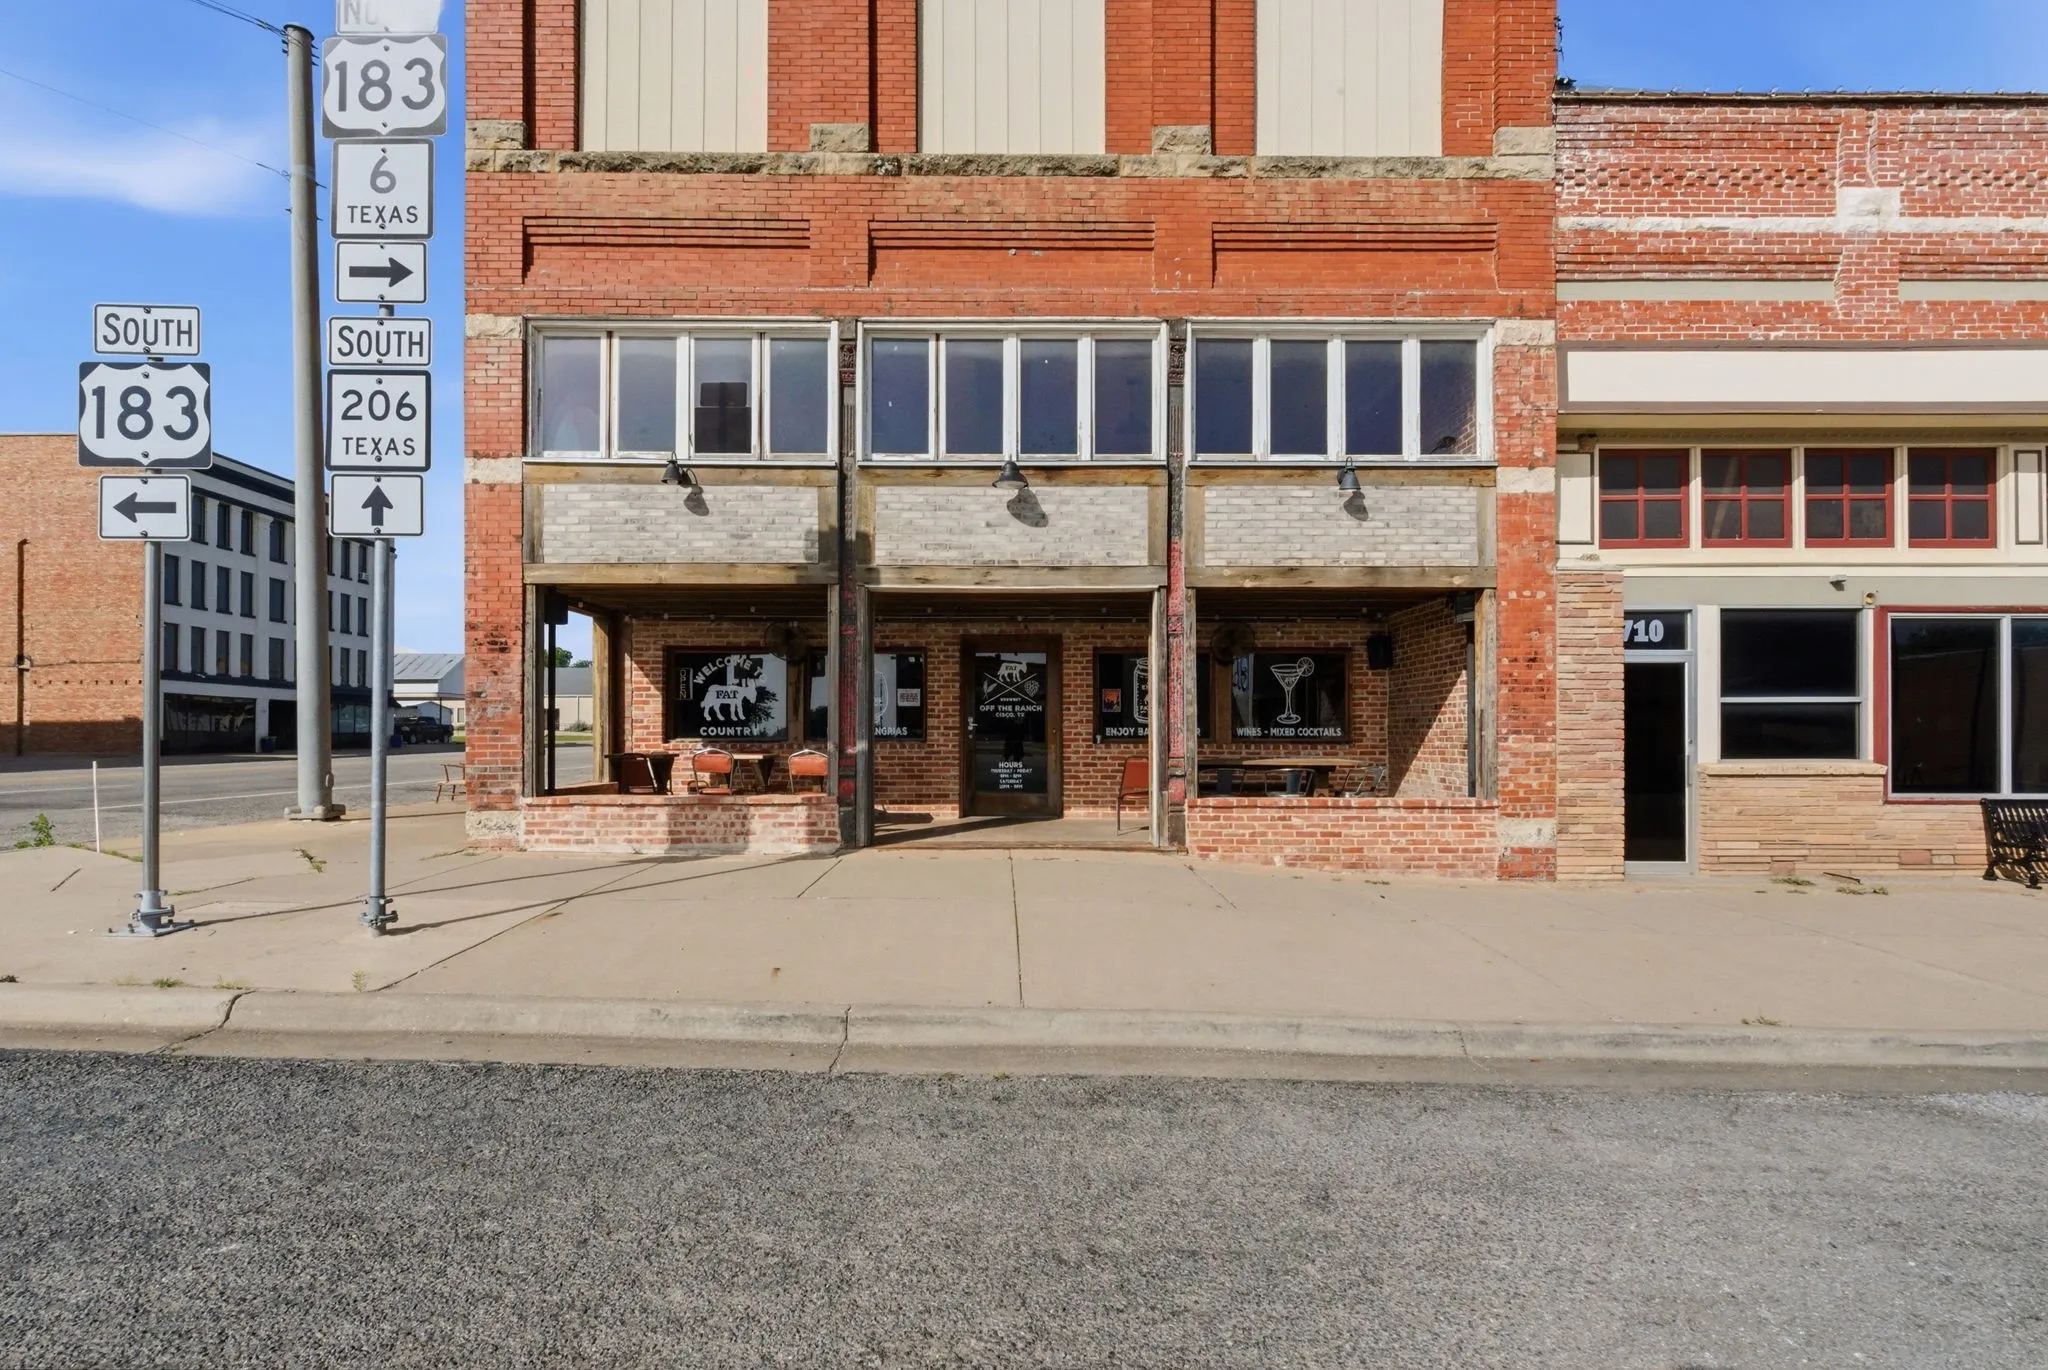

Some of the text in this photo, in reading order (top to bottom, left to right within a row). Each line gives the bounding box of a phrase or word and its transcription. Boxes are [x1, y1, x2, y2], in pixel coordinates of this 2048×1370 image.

[335, 57, 435, 112] 183
[369, 155, 397, 194] 6
[347, 205, 418, 224] TEXAS
[102, 312, 193, 347] SOUTH
[337, 325, 424, 358] SOUTH
[91, 385, 199, 441] 183
[341, 389, 417, 422] 206
[342, 437, 416, 456] TEXAS
[1624, 619, 1664, 643] 710
[693, 654, 753, 685] WELCOME
[715, 690, 738, 700] FAT
[979, 704, 1042, 712] OFF THE RANCH
[700, 727, 760, 737] COUNTRY
[874, 727, 908, 737] NGRIAS
[1105, 728, 1135, 737] ENJOY
[1236, 728, 1262, 737] WINES
[1270, 728, 1296, 737] MIXED
[1297, 728, 1342, 737] COCKTAILS
[998, 761, 1023, 769] HOURS
